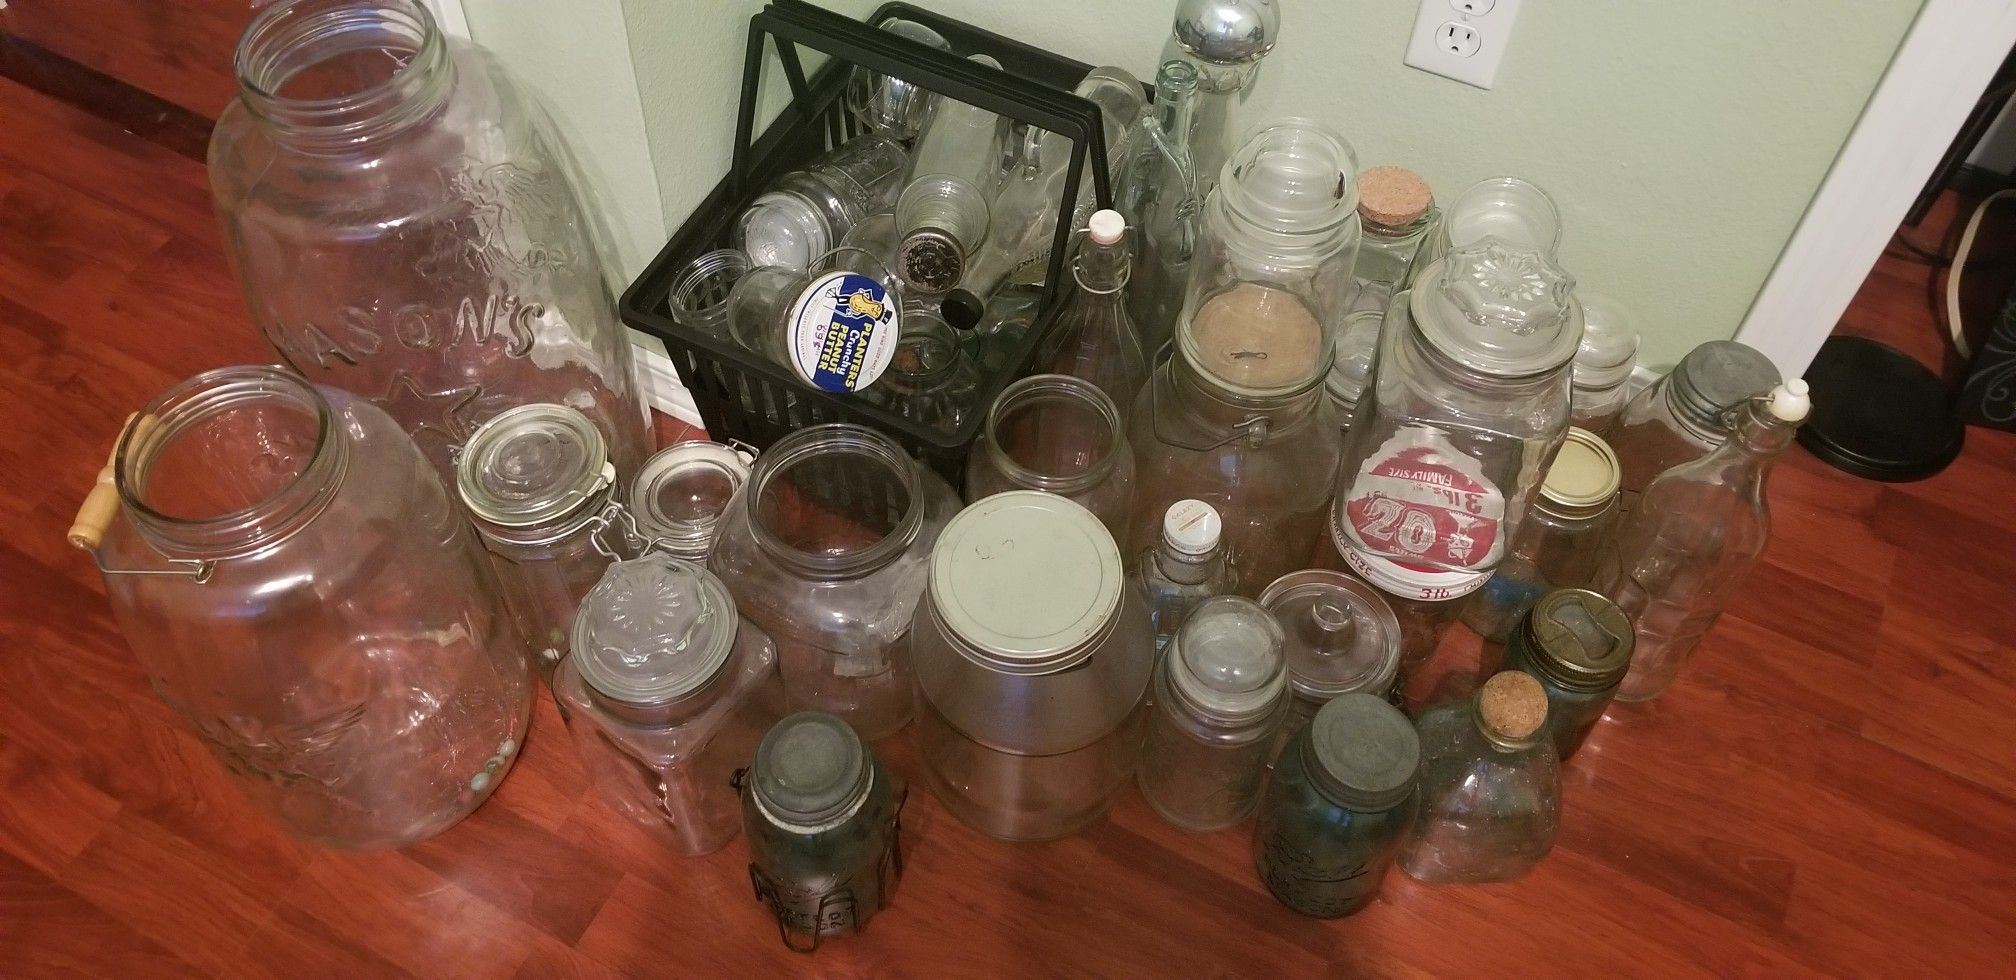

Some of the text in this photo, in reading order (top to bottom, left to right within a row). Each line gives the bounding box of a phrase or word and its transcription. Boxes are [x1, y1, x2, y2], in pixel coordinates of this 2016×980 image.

[818, 321, 841, 370] BUTTER
[828, 324, 849, 375] PEANUT
[836, 329, 860, 376] Crunchy
[845, 322, 873, 388] PLANTERS
[1411, 470, 1453, 487] FAMILY
[1464, 493, 1483, 514] 3
